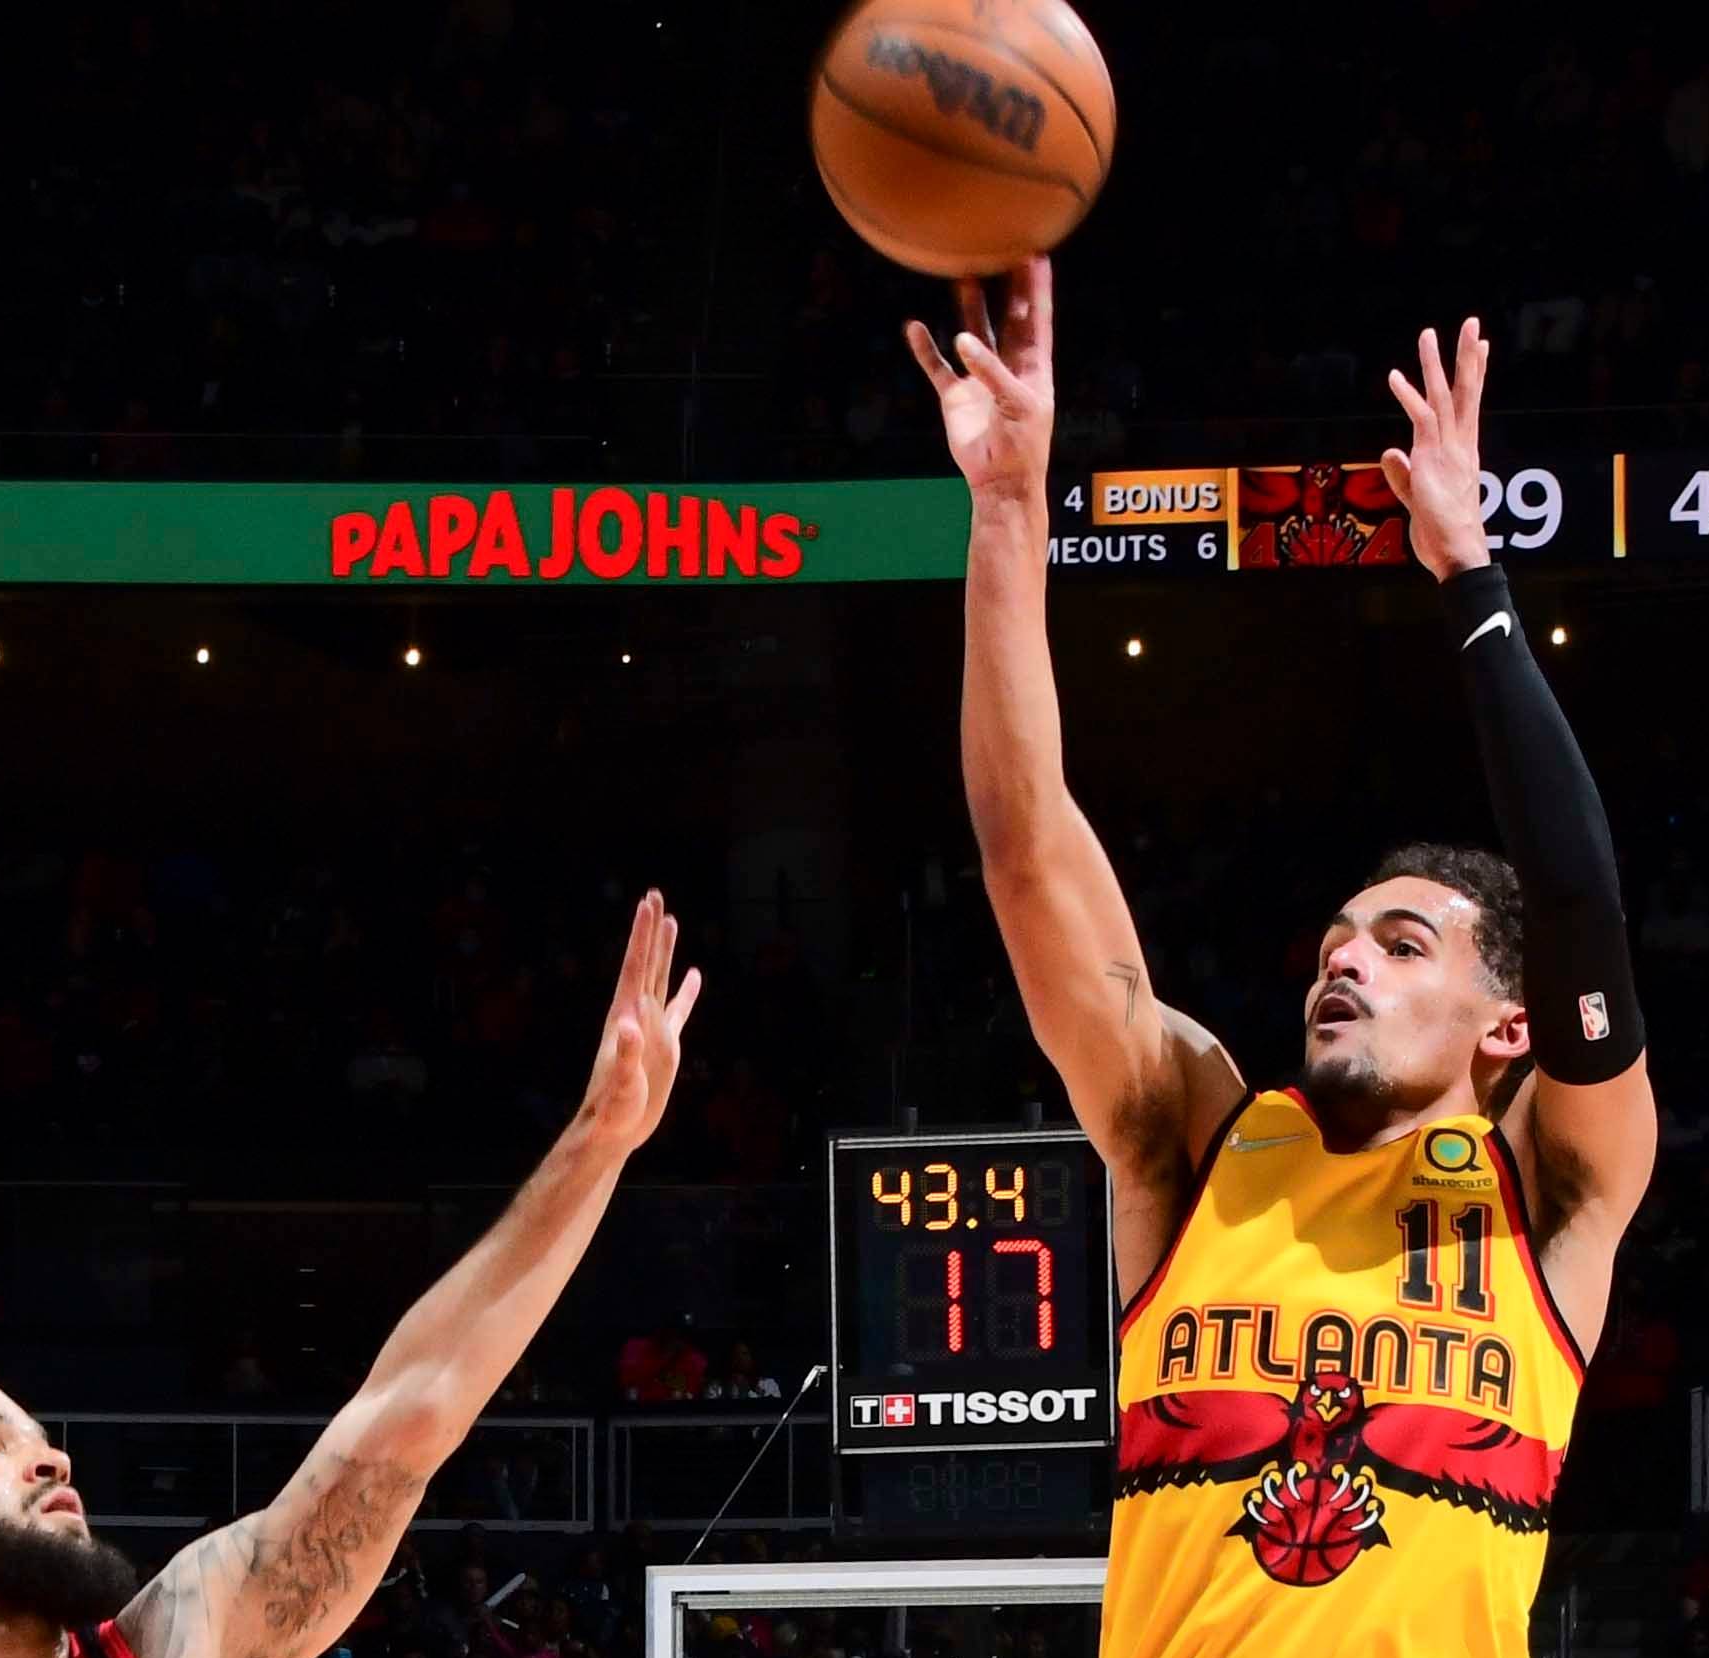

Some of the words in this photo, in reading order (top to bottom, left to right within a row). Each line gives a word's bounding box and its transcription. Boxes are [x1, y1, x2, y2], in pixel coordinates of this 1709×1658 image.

[1063, 484, 1085, 513] 4
[1103, 481, 1219, 514] BONUS
[331, 489, 532, 578] PAPA
[538, 486, 802, 580] JOHNS
[1046, 533, 1167, 565] MEOUTS
[1196, 531, 1218, 561] 6
[871, 1163, 1026, 1231] 43.4
[1411, 1174, 1493, 1190] sharecare
[1395, 1199, 1496, 1322] 11
[947, 1239, 1053, 1352] 17
[1156, 1303, 1517, 1415] ATLANTA
[917, 1388, 1098, 1426] TISSOT
